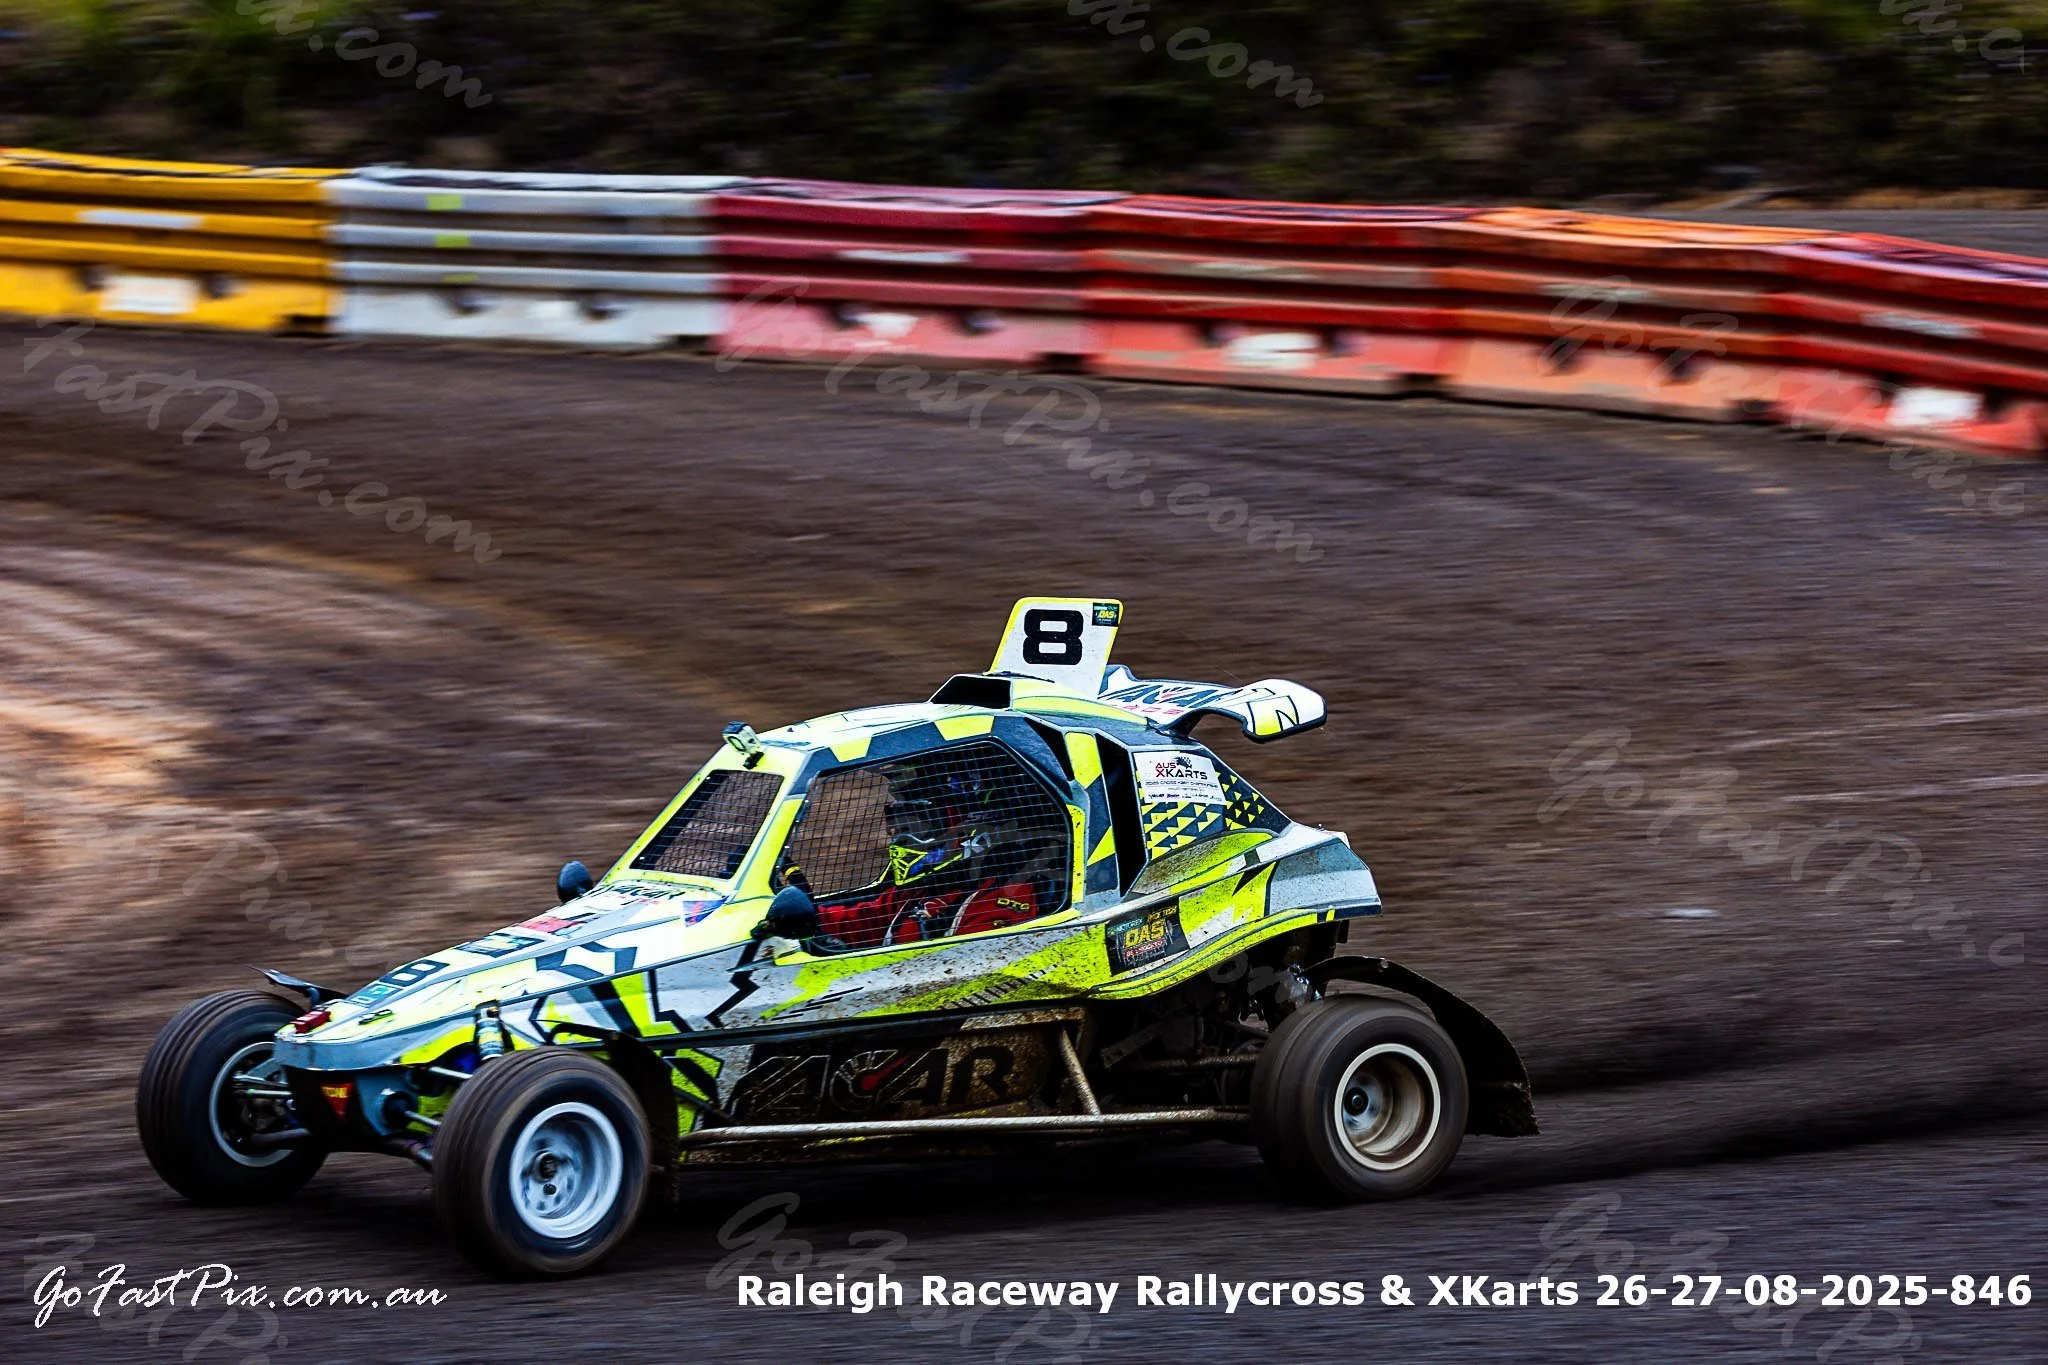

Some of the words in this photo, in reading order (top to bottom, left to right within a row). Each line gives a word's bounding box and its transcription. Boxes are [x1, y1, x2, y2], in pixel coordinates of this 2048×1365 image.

[1022, 608, 1084, 666] 8
[1155, 762, 1177, 770] AUS
[1155, 768, 1208, 780] XKARTS
